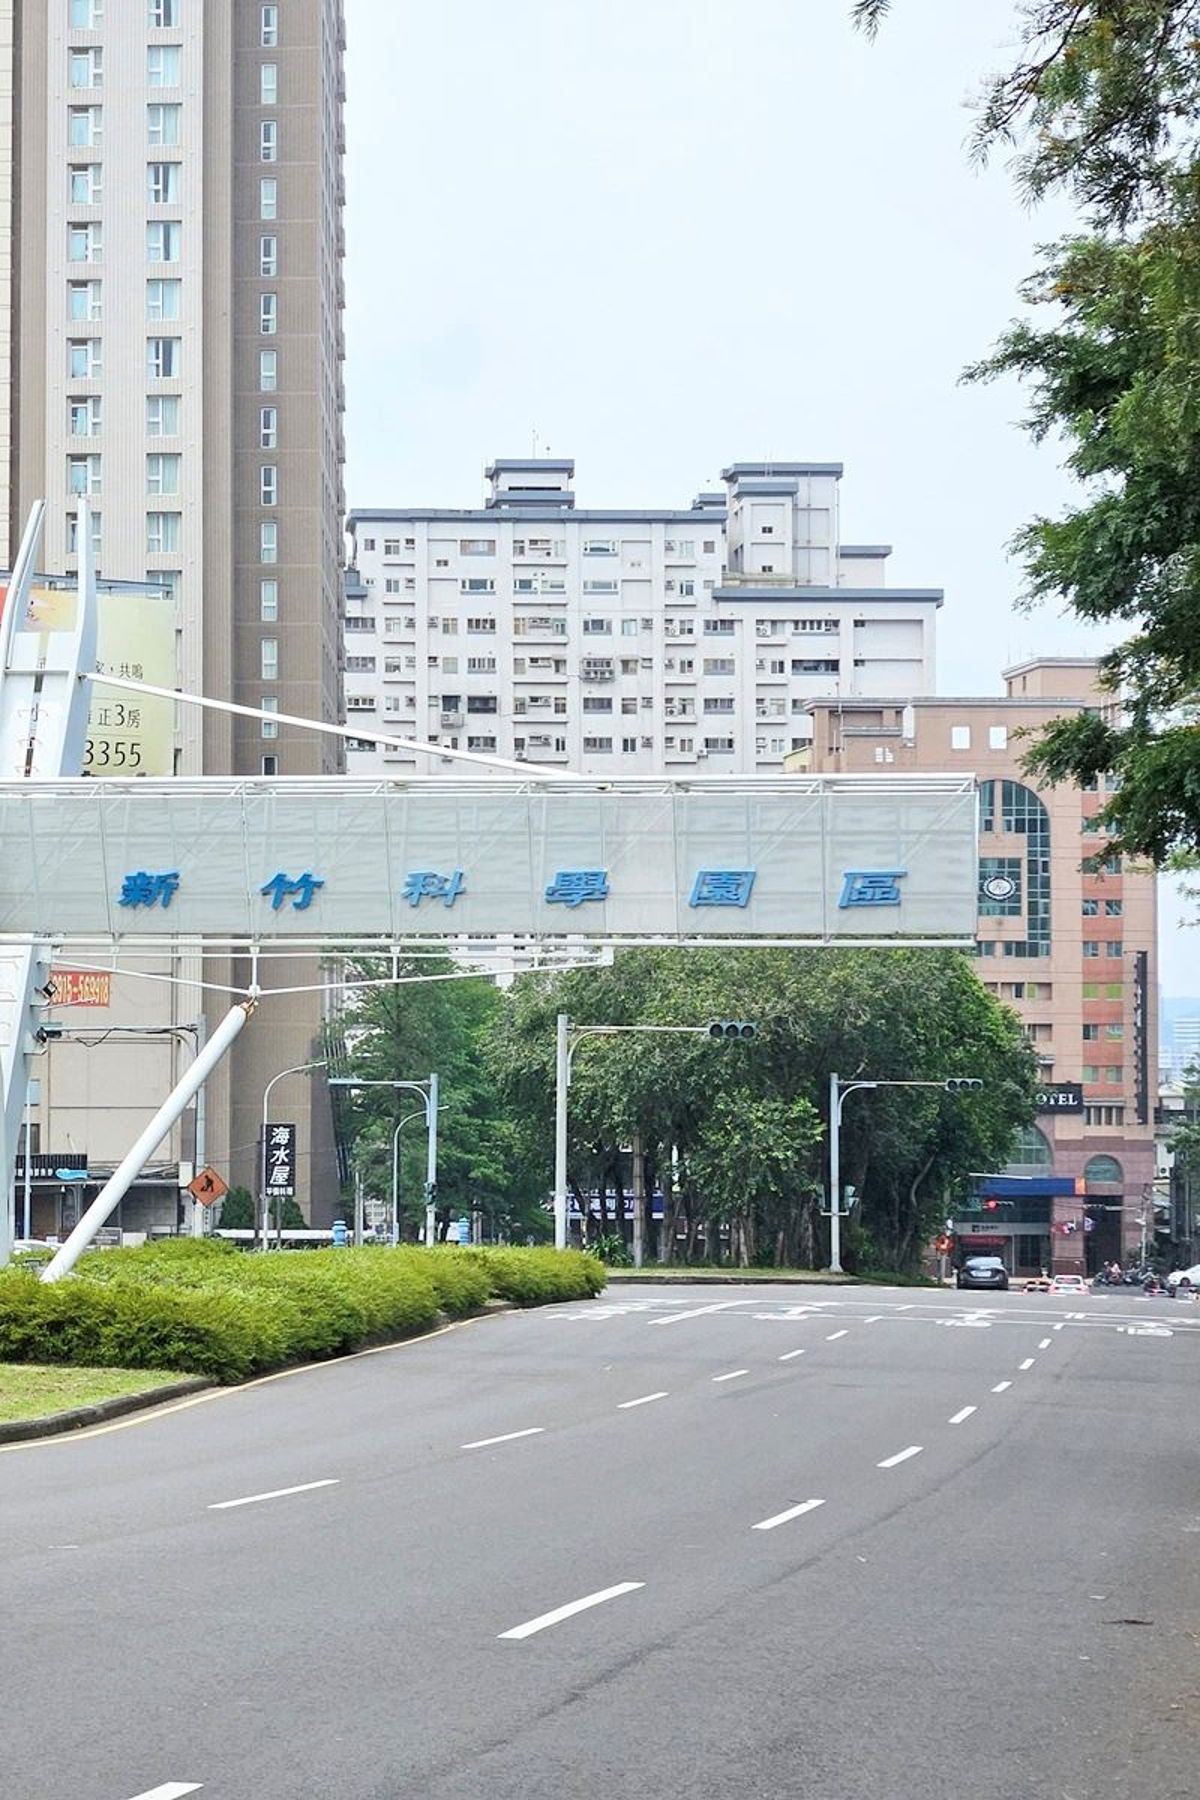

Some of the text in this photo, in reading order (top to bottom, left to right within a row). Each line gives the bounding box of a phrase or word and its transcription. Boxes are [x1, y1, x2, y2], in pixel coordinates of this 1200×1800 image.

[118, 866, 908, 912] 新竹科學園區
[1034, 1092, 1079, 1106] OTEL
[269, 1126, 291, 1186] 海水屋
